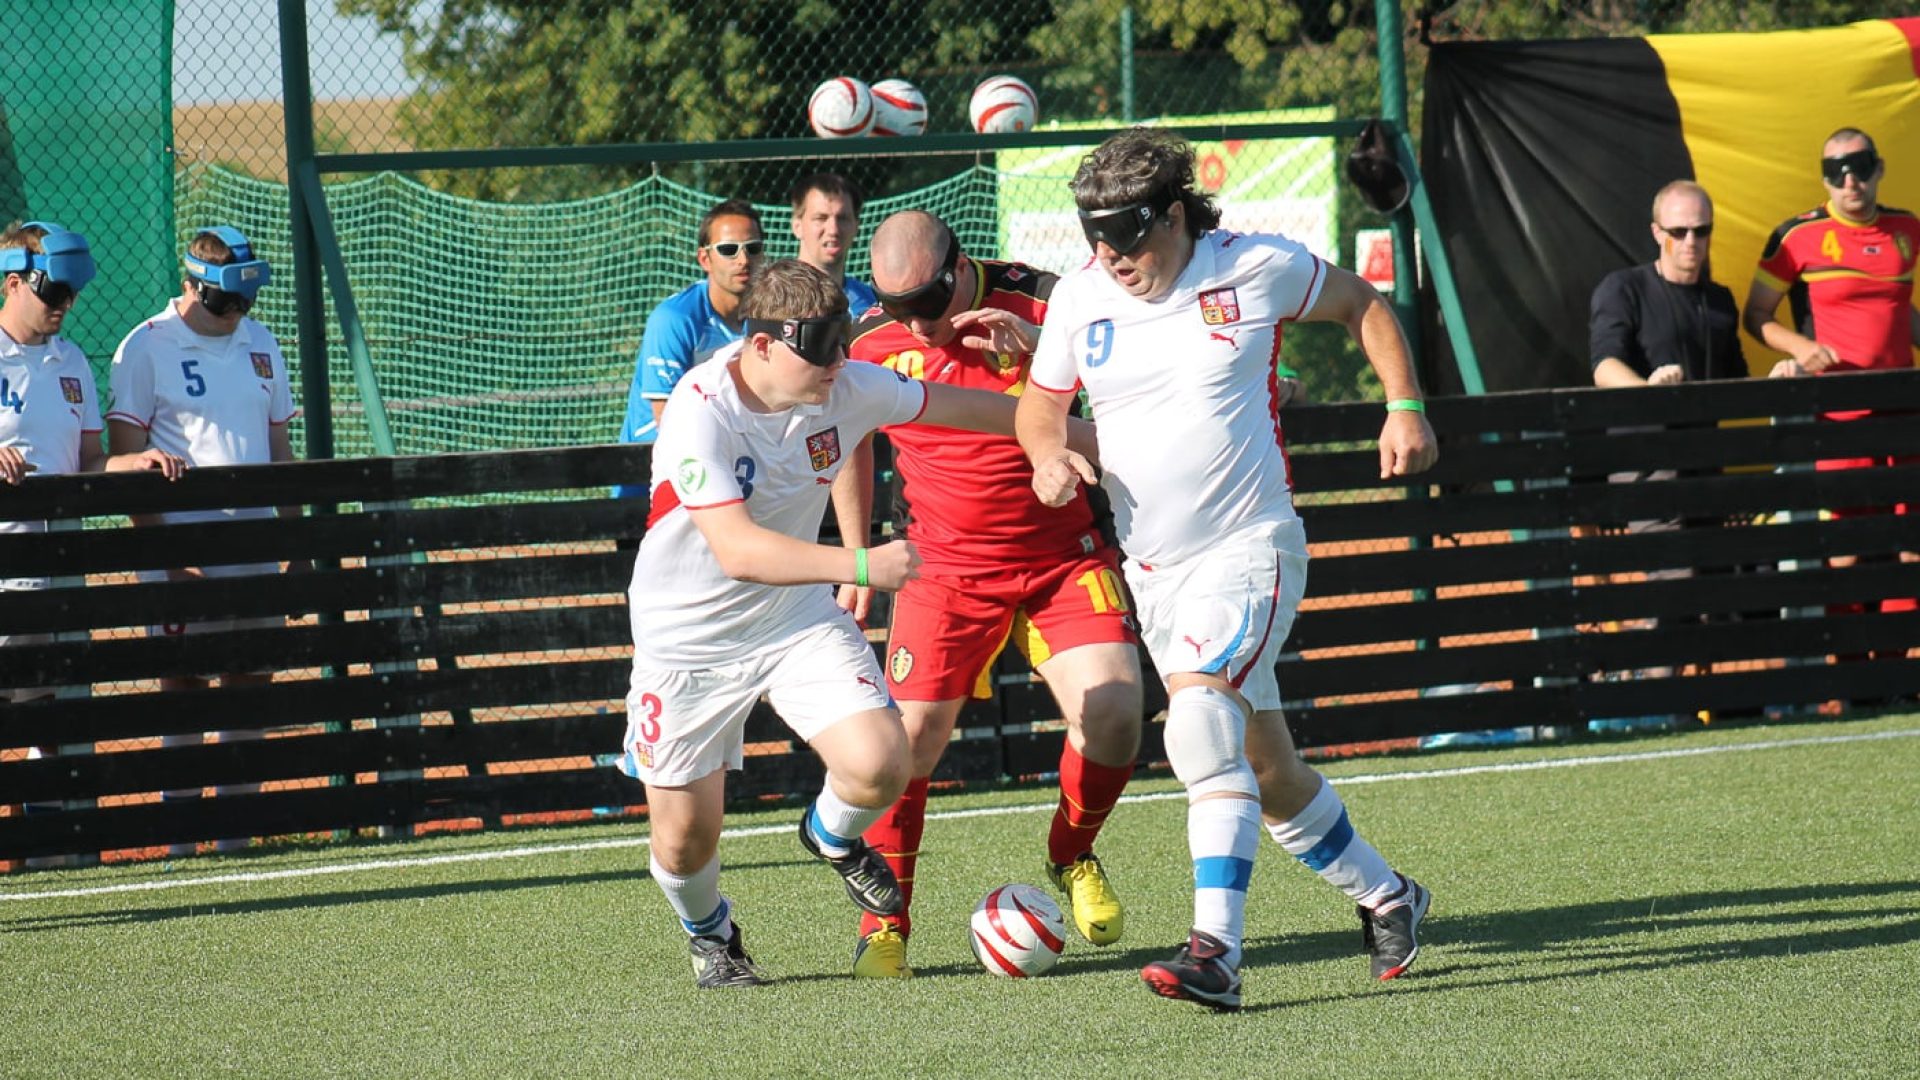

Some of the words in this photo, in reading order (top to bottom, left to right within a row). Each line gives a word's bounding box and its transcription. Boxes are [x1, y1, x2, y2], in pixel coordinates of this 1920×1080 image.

[1821, 229, 1843, 264] 4
[1086, 318, 1114, 368] 9
[1, 377, 23, 414] 4
[181, 360, 206, 396] 5
[735, 455, 755, 500] 3
[1076, 568, 1129, 614] 10
[641, 692, 662, 743] 3
